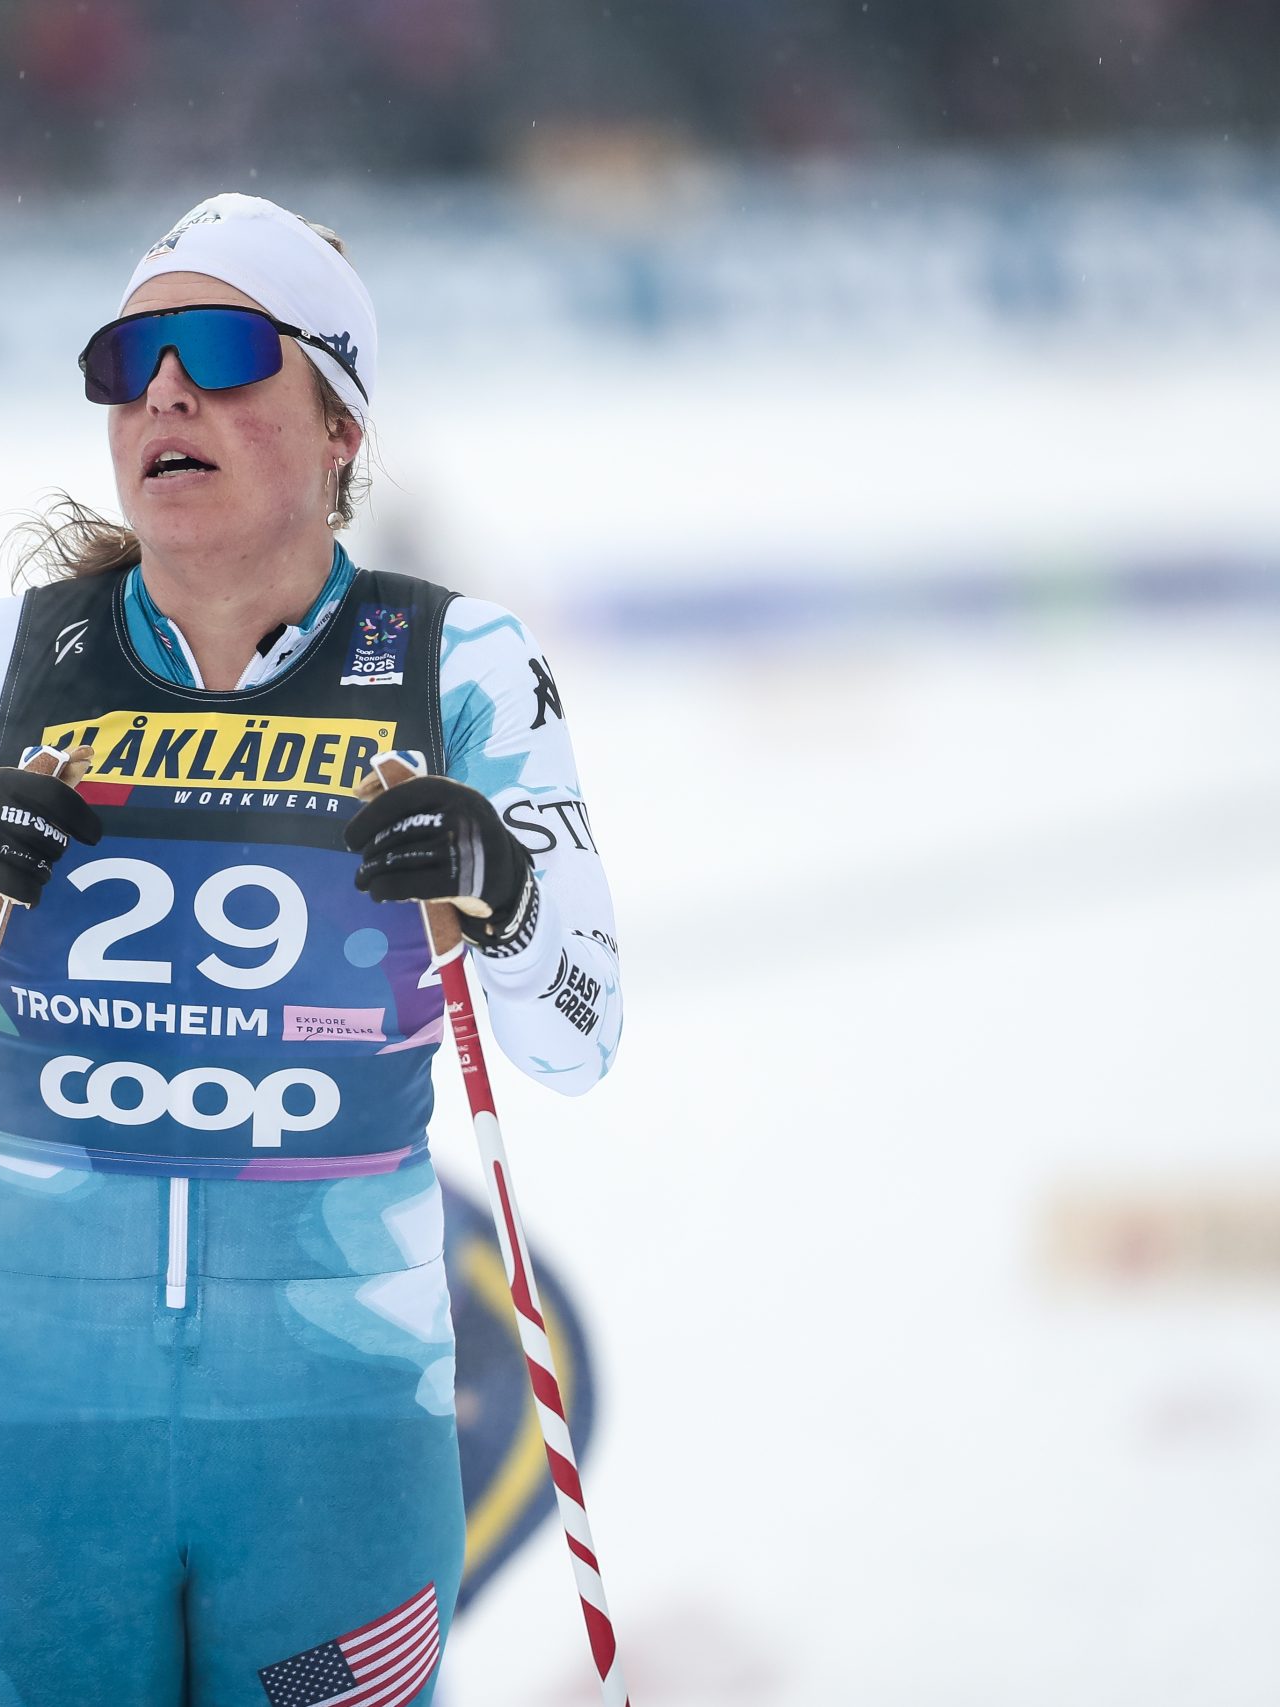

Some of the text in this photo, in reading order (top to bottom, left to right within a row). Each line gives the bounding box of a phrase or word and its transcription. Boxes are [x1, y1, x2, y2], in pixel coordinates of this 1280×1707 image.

[351, 659, 395, 672] 2025
[173, 790, 340, 812] WORKWEAR
[502, 800, 599, 856] STI
[66, 857, 309, 990] 29
[566, 964, 601, 1007] EASY
[11, 986, 268, 1037] TRONDHEIM
[295, 1017, 347, 1026] EXPLORE
[554, 988, 600, 1036] GREEN
[39, 1055, 341, 1148] coop
